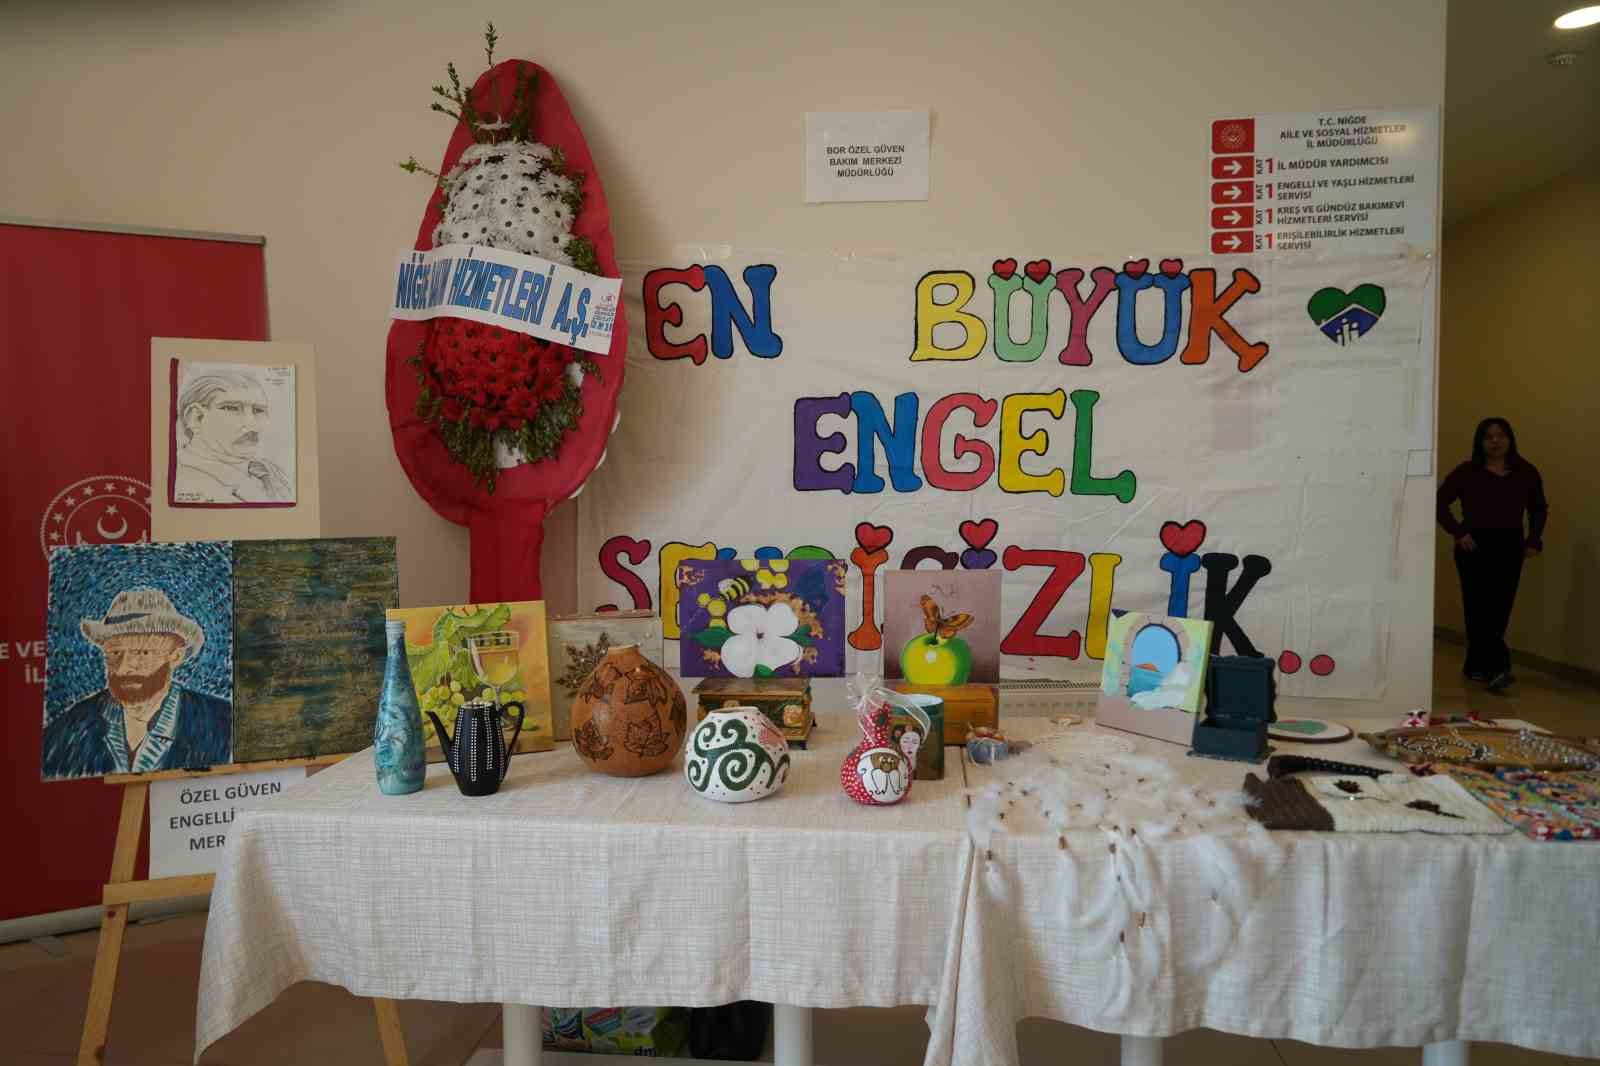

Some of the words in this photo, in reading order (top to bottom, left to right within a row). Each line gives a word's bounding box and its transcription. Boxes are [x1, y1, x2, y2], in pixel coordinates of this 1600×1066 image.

[1319, 118, 1336, 126] T.C.
[1337, 115, 1367, 125] NİĞDE
[1280, 129, 1300, 139] AİLE
[1302, 129, 1314, 138] VE
[1315, 127, 1352, 137] SOSYAL
[827, 146, 846, 155] BOR
[848, 145, 872, 154] ÖZEL
[873, 144, 904, 154] GÜVEN
[1306, 138, 1315, 149] İL
[1316, 136, 1378, 148] MÜDÜRLÜĞÜ
[830, 158, 858, 167] BAKIM
[1265, 158, 1273, 174] 1
[1277, 160, 1286, 170] İL
[1288, 159, 1327, 170] MÜDÜR
[1330, 157, 1389, 168] YARDIMCISI
[837, 168, 894, 177] MÜDÜRLÜĞÜ
[1265, 183, 1273, 199] 1
[1277, 179, 1315, 190] ENGELLİ
[1317, 179, 1329, 188] VE
[1332, 178, 1357, 188] YAŞLI
[1359, 174, 1415, 186] HİZMETLERİ
[1278, 191, 1312, 200] SERVİSİ
[1265, 208, 1273, 224] 1
[1278, 206, 1300, 215] KREŞ
[1302, 205, 1314, 213] VE
[1316, 202, 1357, 213] GÜNDÜZ
[1359, 200, 1405, 210] BAKIMEVİ
[1277, 214, 1332, 224] HİZMETLERİ
[1334, 212, 1369, 222] SERVİSİ
[1265, 233, 1273, 249] 1
[1277, 229, 1347, 240] ERİŞİLEBİLİRLİK
[1350, 225, 1405, 237] HİZMETLERİ
[1278, 240, 1312, 250] SERVİSİ
[448, 247, 556, 326] HİZMETLERİ
[551, 282, 592, 345] A.Ş.
[643, 264, 783, 366] EN
[909, 257, 1269, 373] BÜYÜK
[793, 386, 1137, 503] ENGEL
[16, 641, 46, 658] VE
[180, 789, 220, 805] ÖZEL
[225, 781, 281, 800] GÜVEN
[170, 807, 235, 830] ENGELLİ
